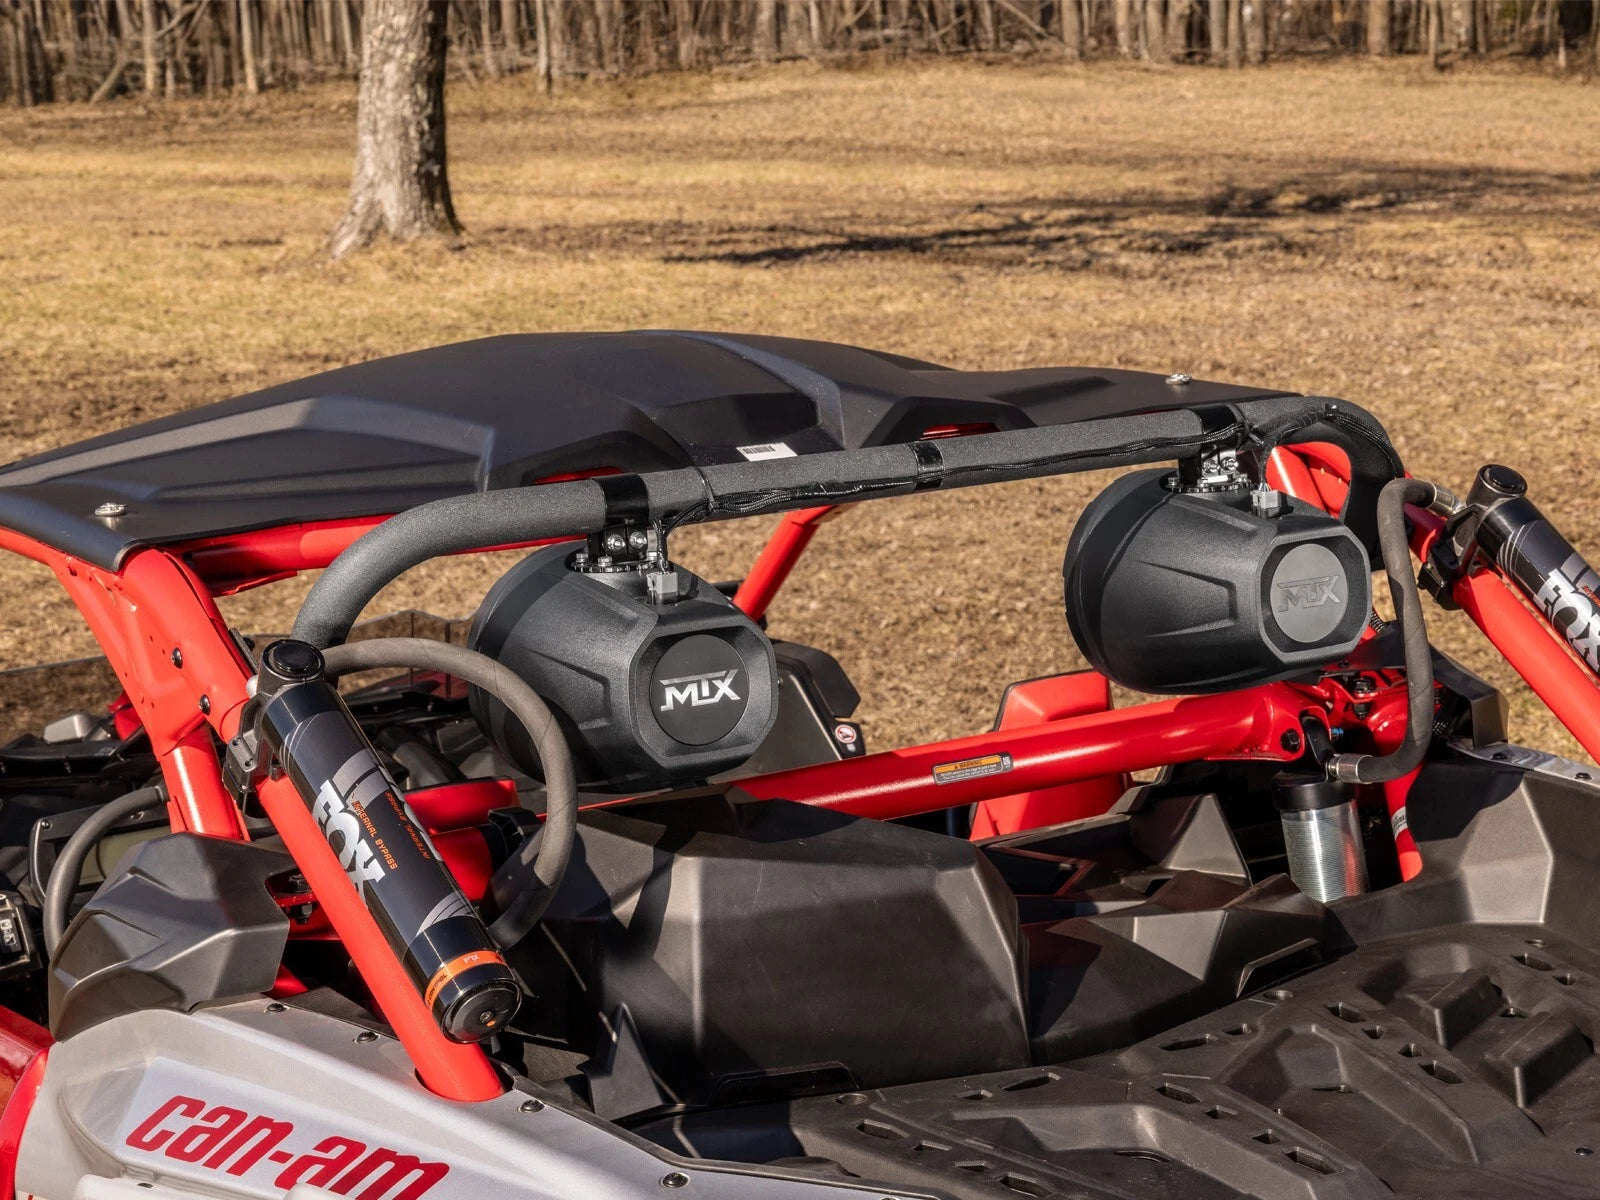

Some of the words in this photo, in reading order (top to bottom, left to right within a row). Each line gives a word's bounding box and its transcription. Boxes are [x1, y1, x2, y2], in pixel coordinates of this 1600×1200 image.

[1277, 575, 1340, 612] MTX
[660, 668, 741, 711] MTX
[351, 800, 378, 838] INTERNAL
[374, 838, 398, 870] BYPASS
[125, 1095, 451, 1200] can-am
